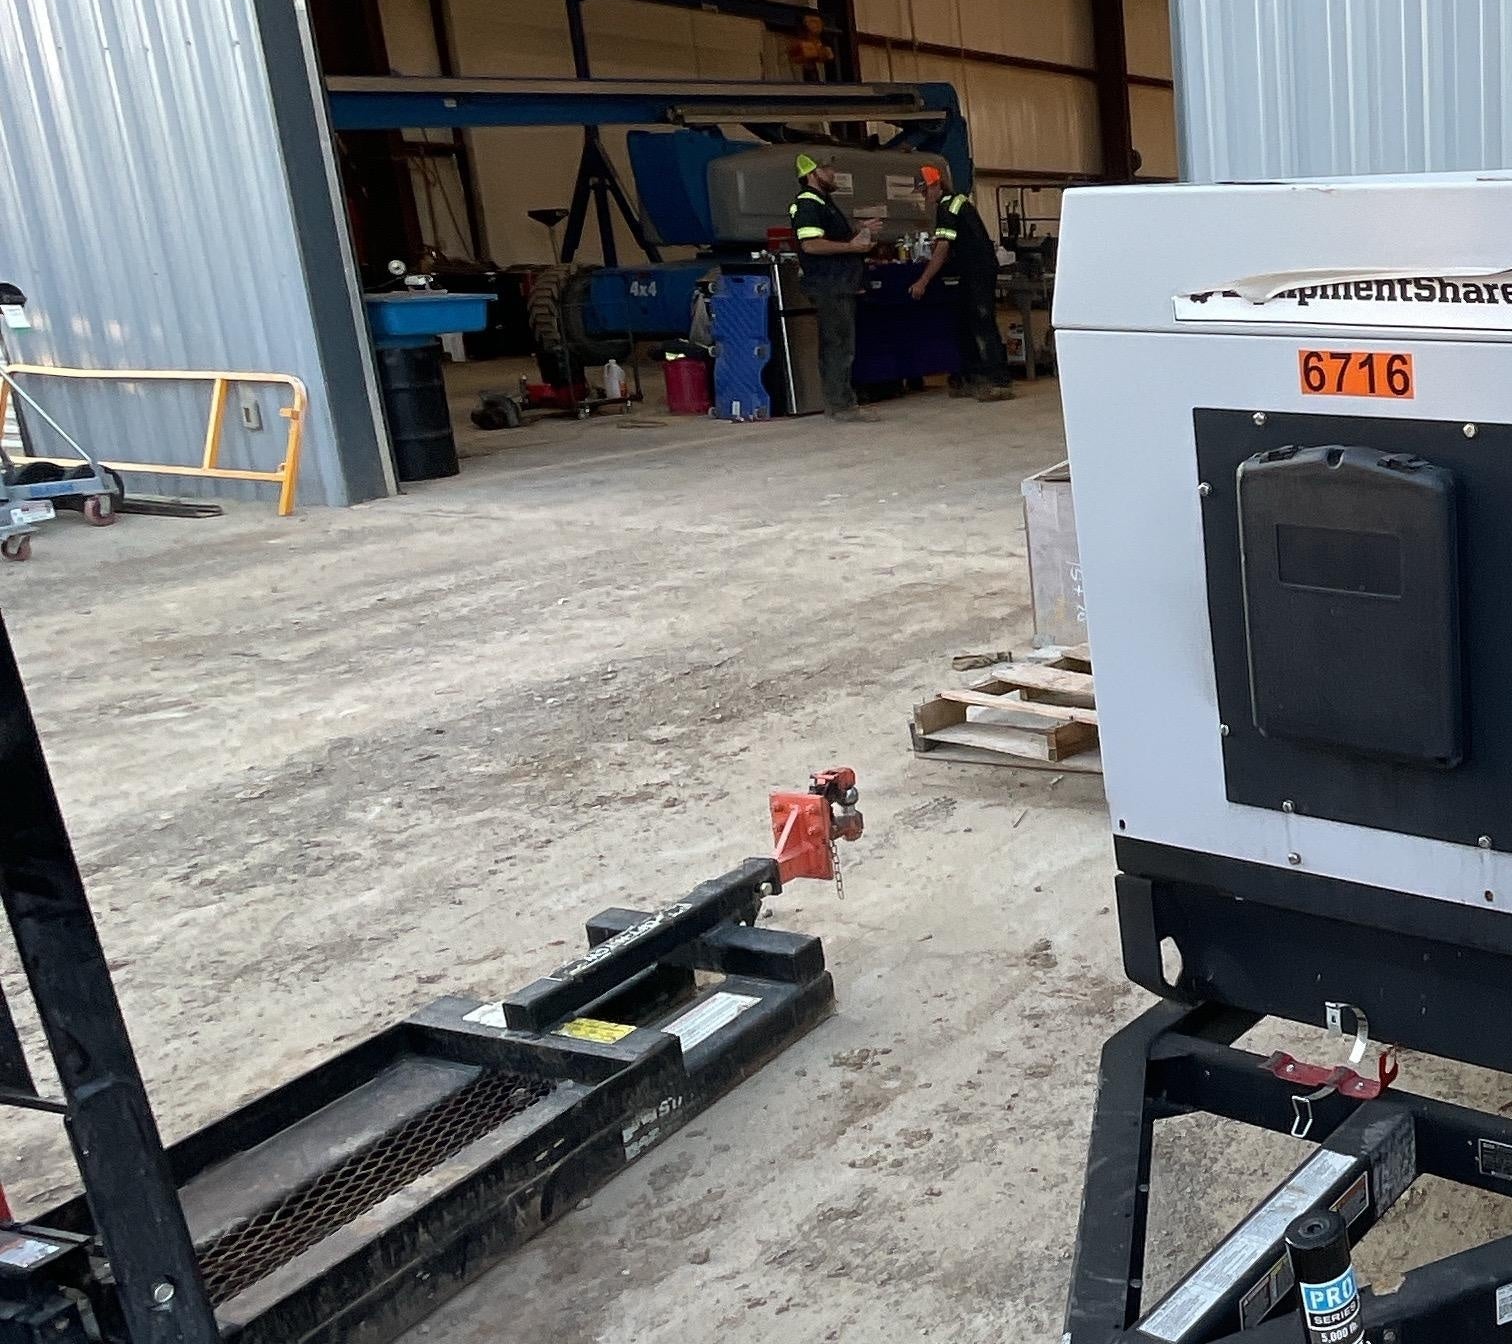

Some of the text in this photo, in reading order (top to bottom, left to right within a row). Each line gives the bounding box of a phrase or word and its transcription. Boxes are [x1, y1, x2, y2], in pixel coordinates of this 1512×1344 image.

[630, 281, 657, 296] 4x4
[1303, 351, 1410, 396] 6716
[1310, 1276, 1353, 1309] PRO
[1314, 1301, 1357, 1324] SERIES
[1321, 1327, 1348, 1343] 5,000
